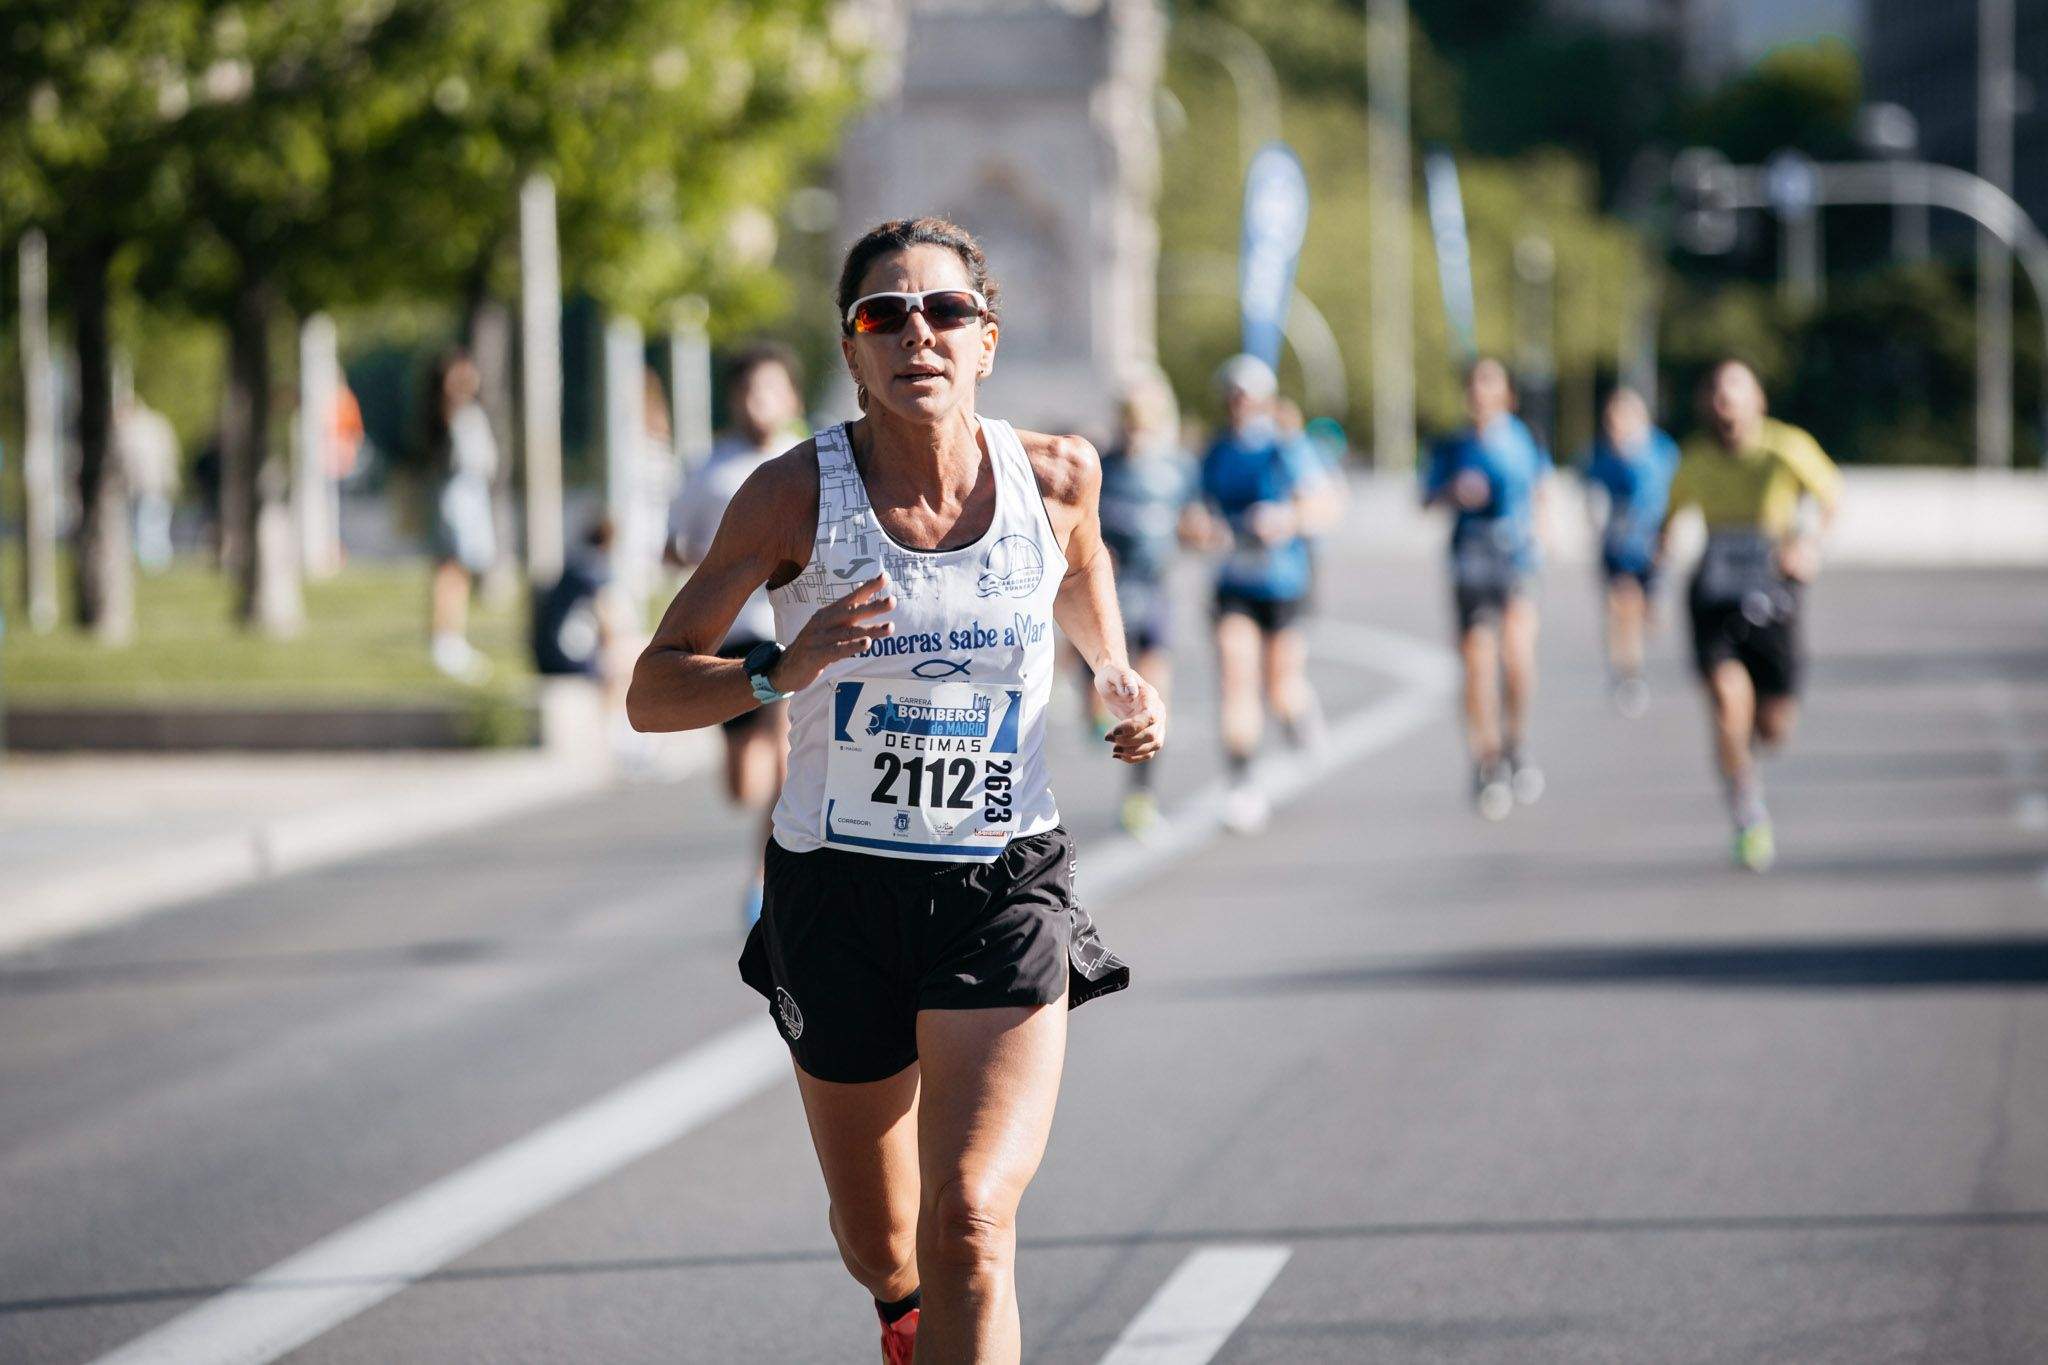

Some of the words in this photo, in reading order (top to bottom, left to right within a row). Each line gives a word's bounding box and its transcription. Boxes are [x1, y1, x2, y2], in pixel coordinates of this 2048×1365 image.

[850, 631, 942, 658] oneras
[949, 620, 998, 651] sabe
[1004, 627, 1015, 647] a
[899, 696, 933, 707] CARRERA
[897, 705, 986, 723] BOMBEROS
[930, 723, 943, 735] de
[945, 722, 986, 736] MADRID
[885, 733, 982, 752] DECIMAS
[870, 752, 976, 809] 2112
[984, 759, 1013, 823] 2623
